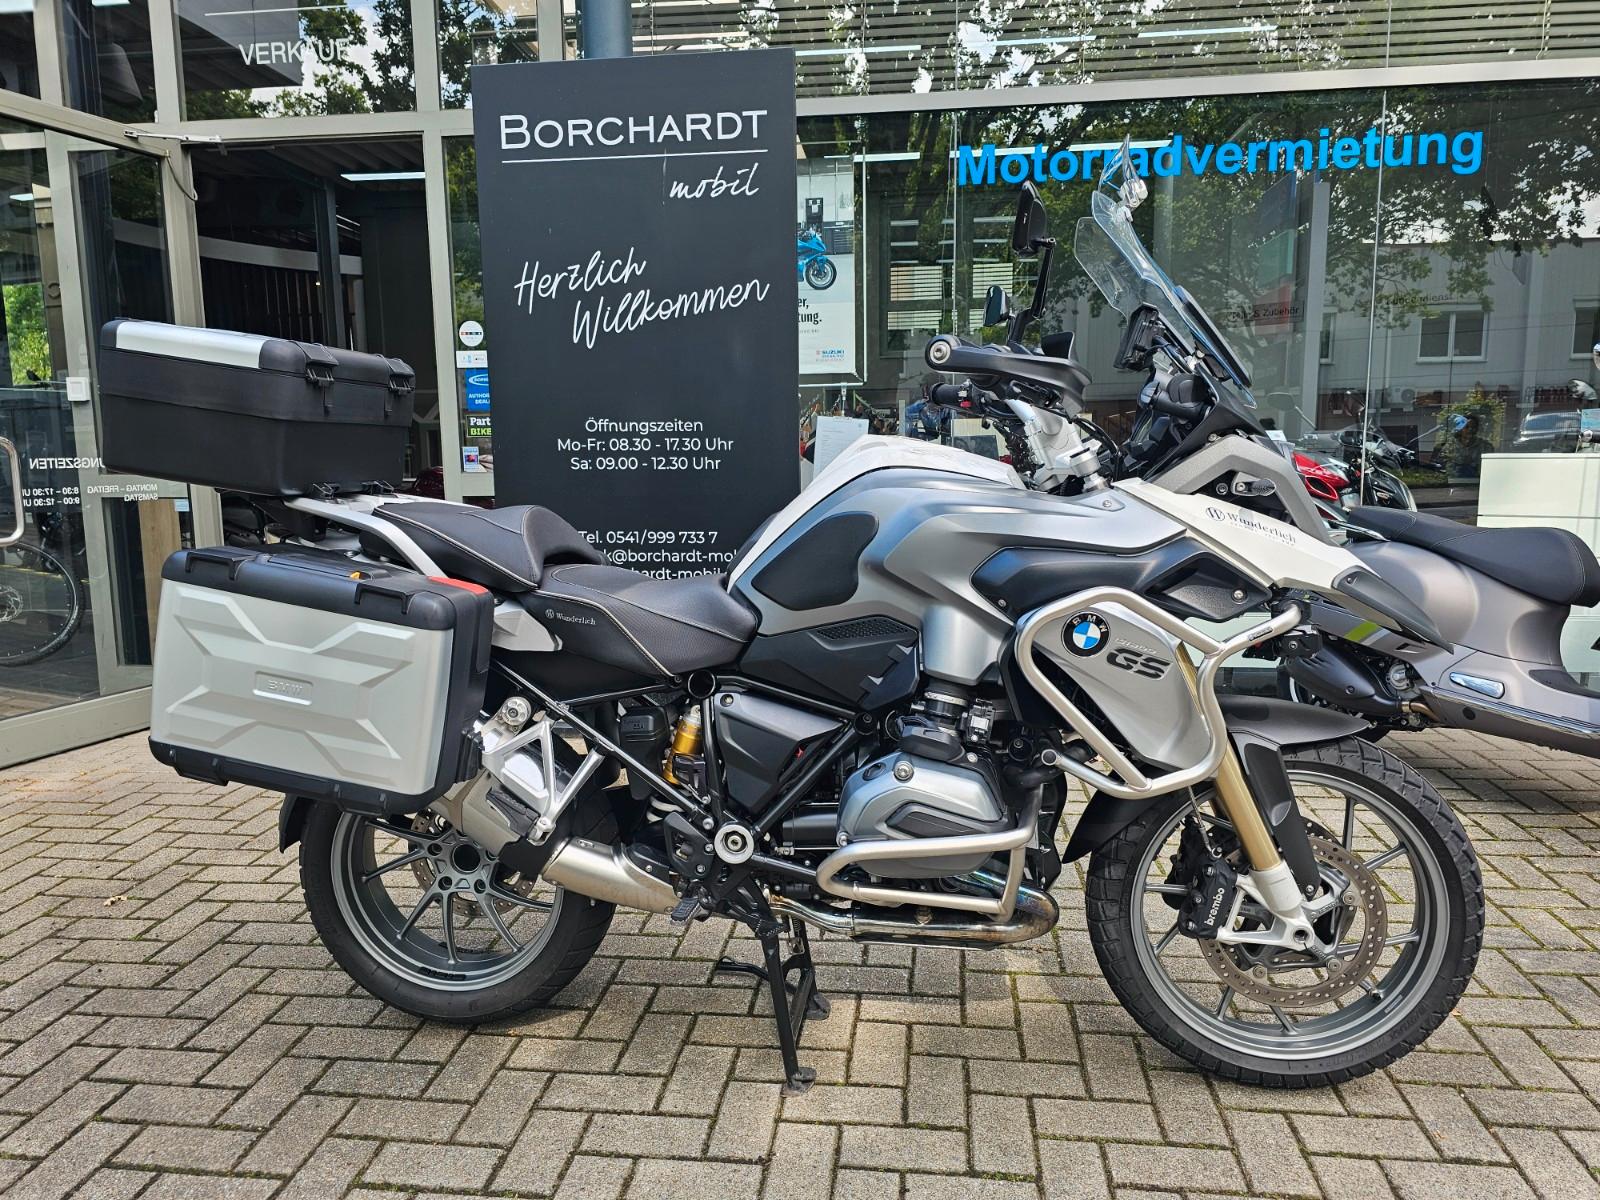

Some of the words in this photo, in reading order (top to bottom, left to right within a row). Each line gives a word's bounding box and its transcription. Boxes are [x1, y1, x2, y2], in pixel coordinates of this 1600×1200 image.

[238, 37, 350, 66] VERKAUF
[499, 109, 768, 150] BORCHARDT
[957, 128, 1484, 187] Motorradvermietung
[669, 162, 760, 199] mobil
[513, 246, 647, 315] Herzlich
[571, 279, 771, 350] Willkommen
[585, 416, 703, 435] Öffnungszeiten
[557, 438, 606, 451] Mo-Fr:
[609, 438, 651, 451] 08.30
[664, 438, 701, 451] 17.30
[705, 437, 734, 451] Uhr
[570, 457, 592, 470] Sa:
[596, 457, 638, 470] 09.00
[651, 457, 689, 470] 12.30
[693, 457, 721, 470] Uhr
[578, 531, 603, 544] Tel.
[606, 529, 675, 546] 0541/999
[679, 531, 705, 544] 733
[709, 531, 718, 544] 7
[1226, 511, 1296, 544] Wunderlich
[556, 611, 597, 626] Wunderlich
[1072, 614, 1108, 633] BMW
[1106, 648, 1171, 679] GS
[1203, 887, 1225, 926] brembo
